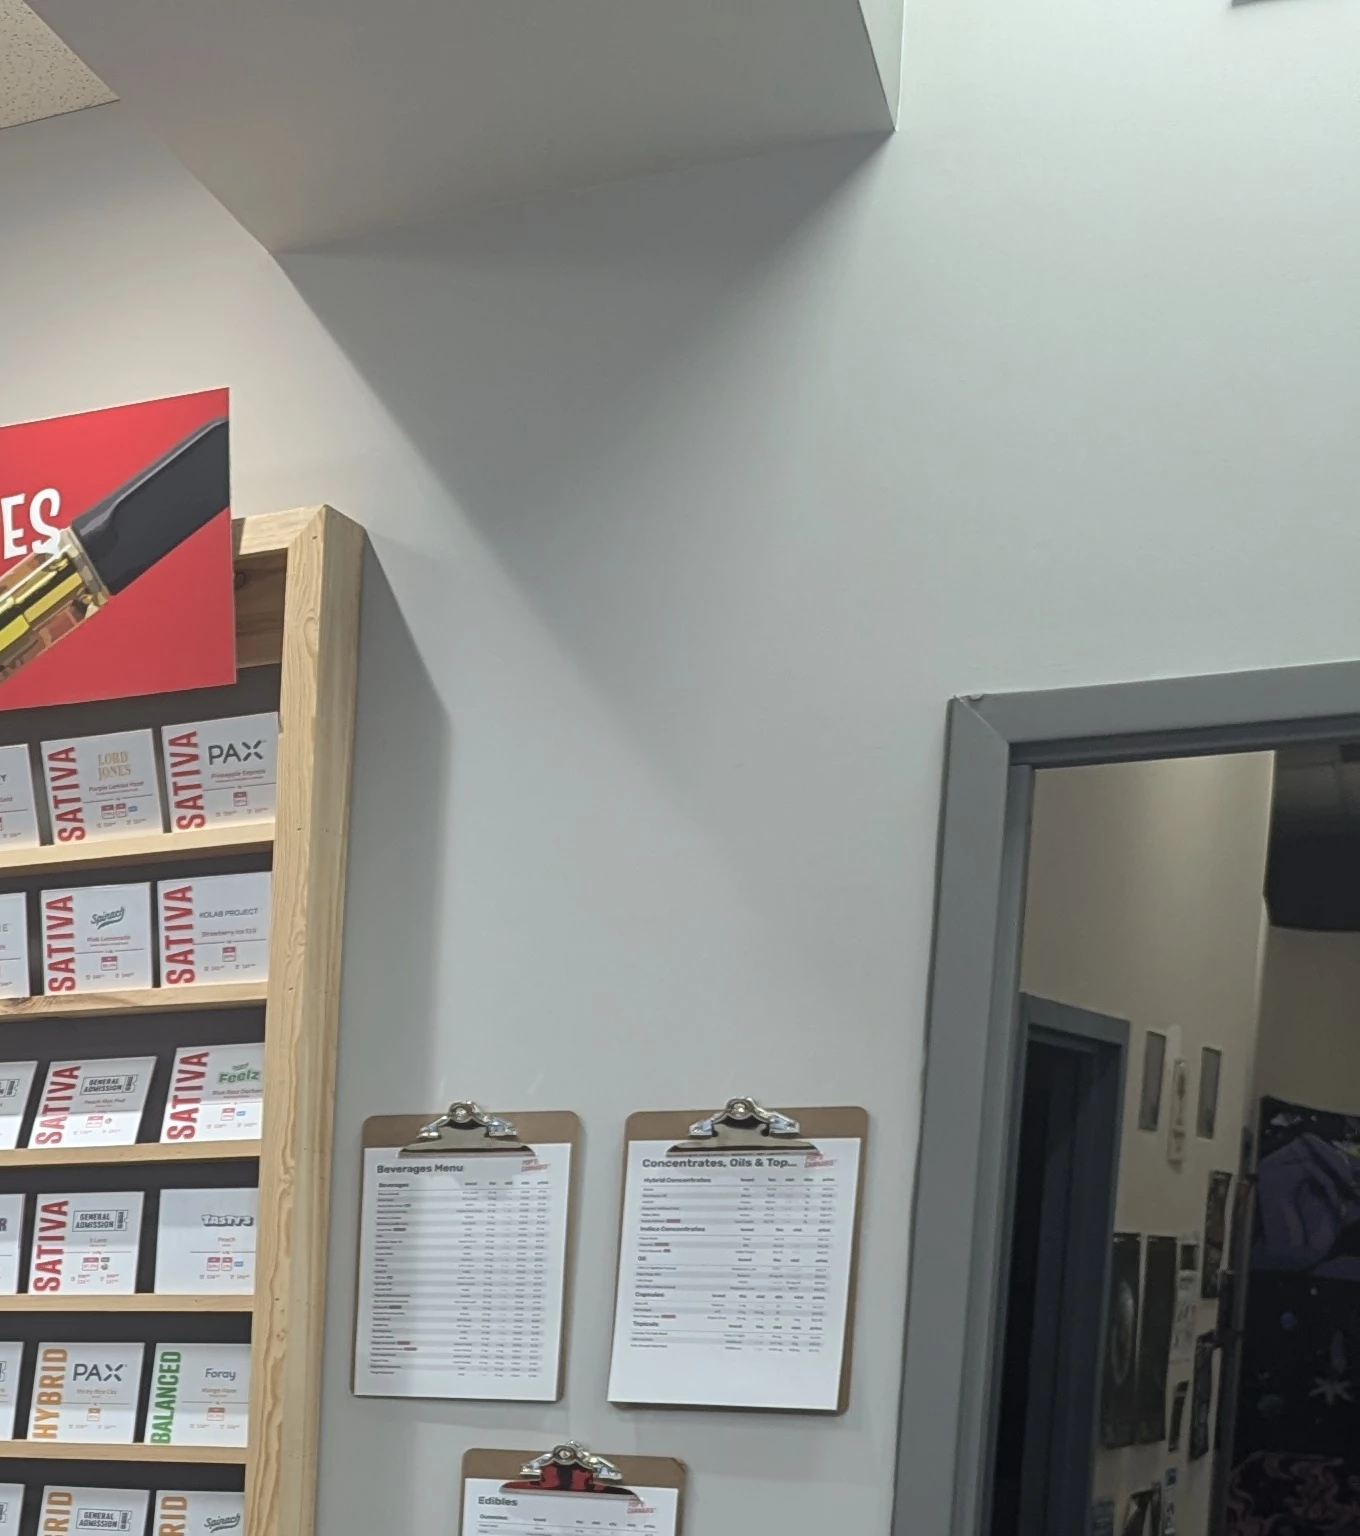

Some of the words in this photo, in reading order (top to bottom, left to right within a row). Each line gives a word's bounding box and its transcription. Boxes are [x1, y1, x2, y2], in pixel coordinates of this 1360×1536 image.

[208, 741, 263, 766] PAX
[168, 730, 206, 830] SATIVA
[199, 908, 223, 919] KOLAB
[225, 907, 259, 918] PROJECT
[376, 1165, 432, 1175] Beverages
[434, 1164, 464, 1173] Menu
[642, 1158, 727, 1169] Concentrates,
[730, 1157, 752, 1167] Oils
[755, 1158, 763, 1167] &
[72, 1362, 124, 1382] PAX
[205, 1368, 237, 1382] Foray
[478, 1496, 519, 1507] Edibles
